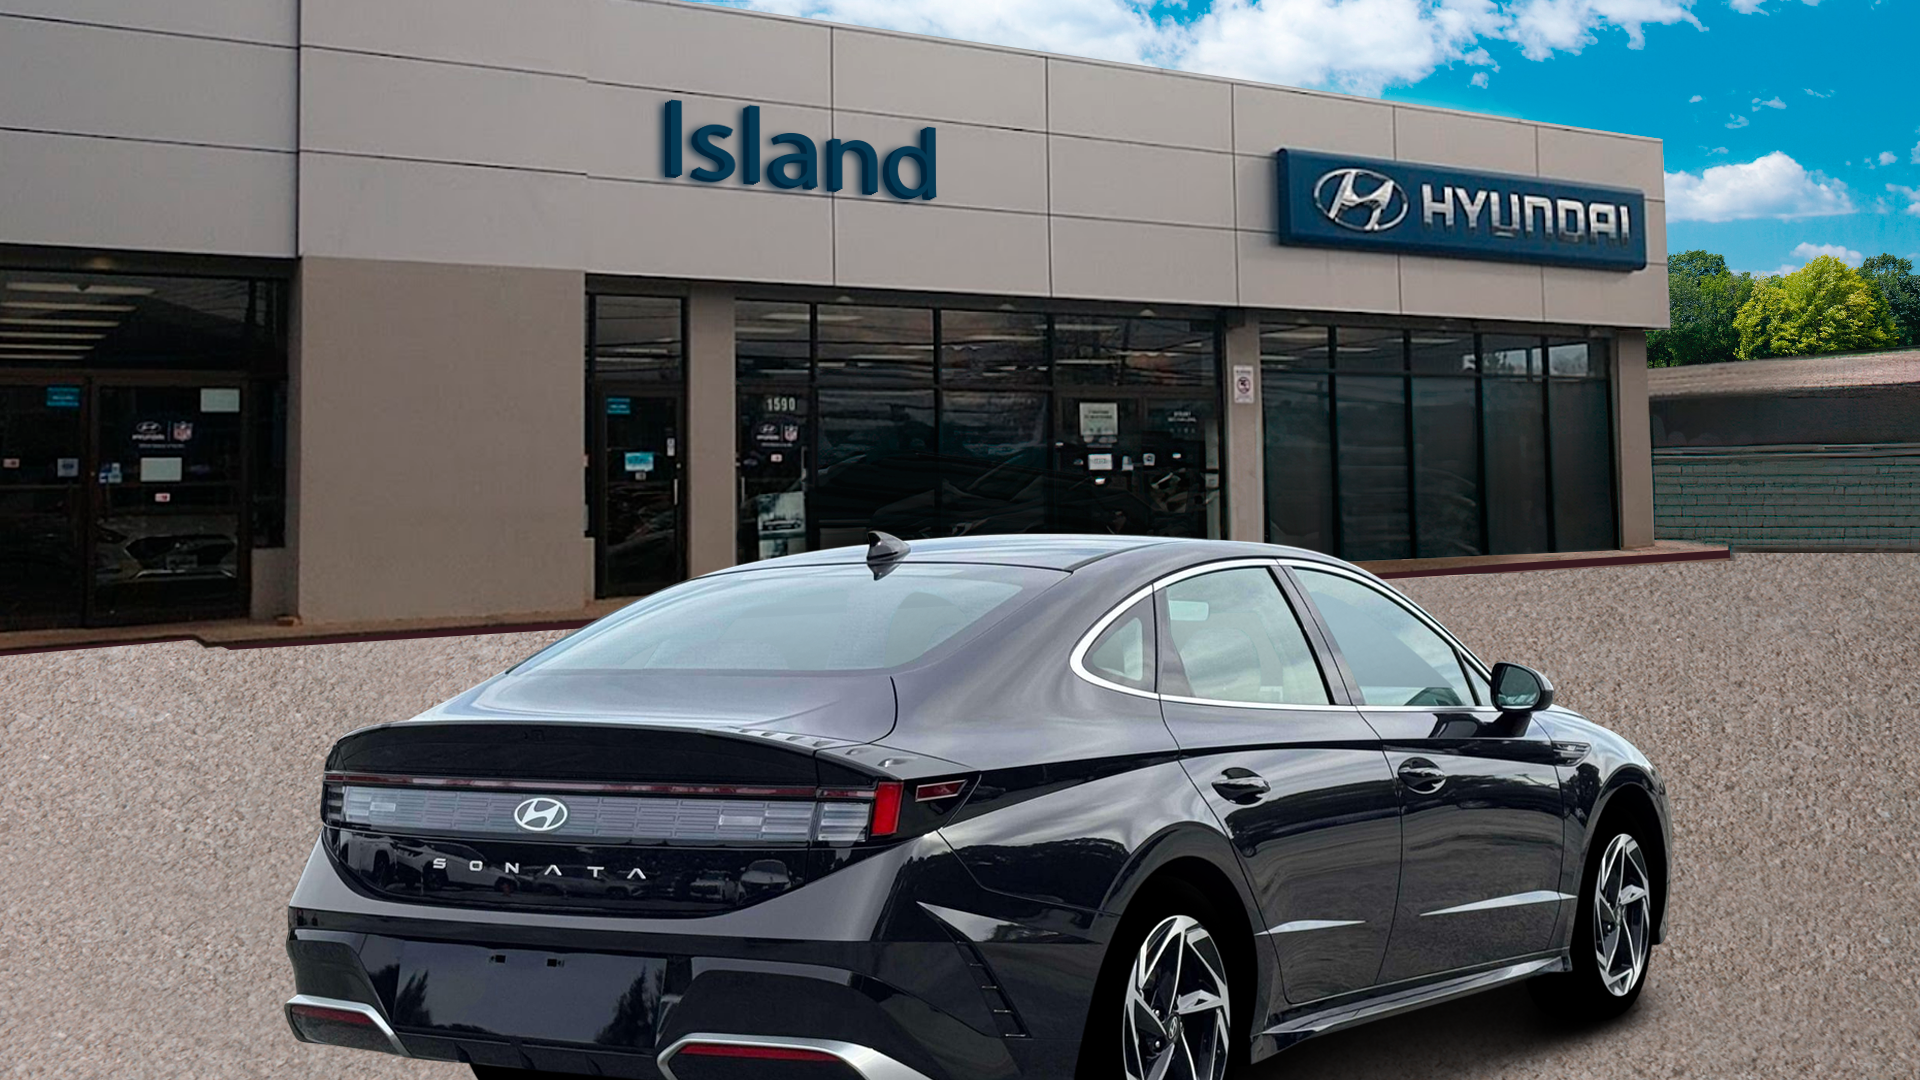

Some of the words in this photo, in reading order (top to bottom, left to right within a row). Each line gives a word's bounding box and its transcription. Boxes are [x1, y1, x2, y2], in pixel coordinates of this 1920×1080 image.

[664, 99, 937, 201] Island
[1421, 183, 1631, 243] HYUNDAI
[767, 397, 796, 411] 1590
[433, 858, 647, 880] SONATA
